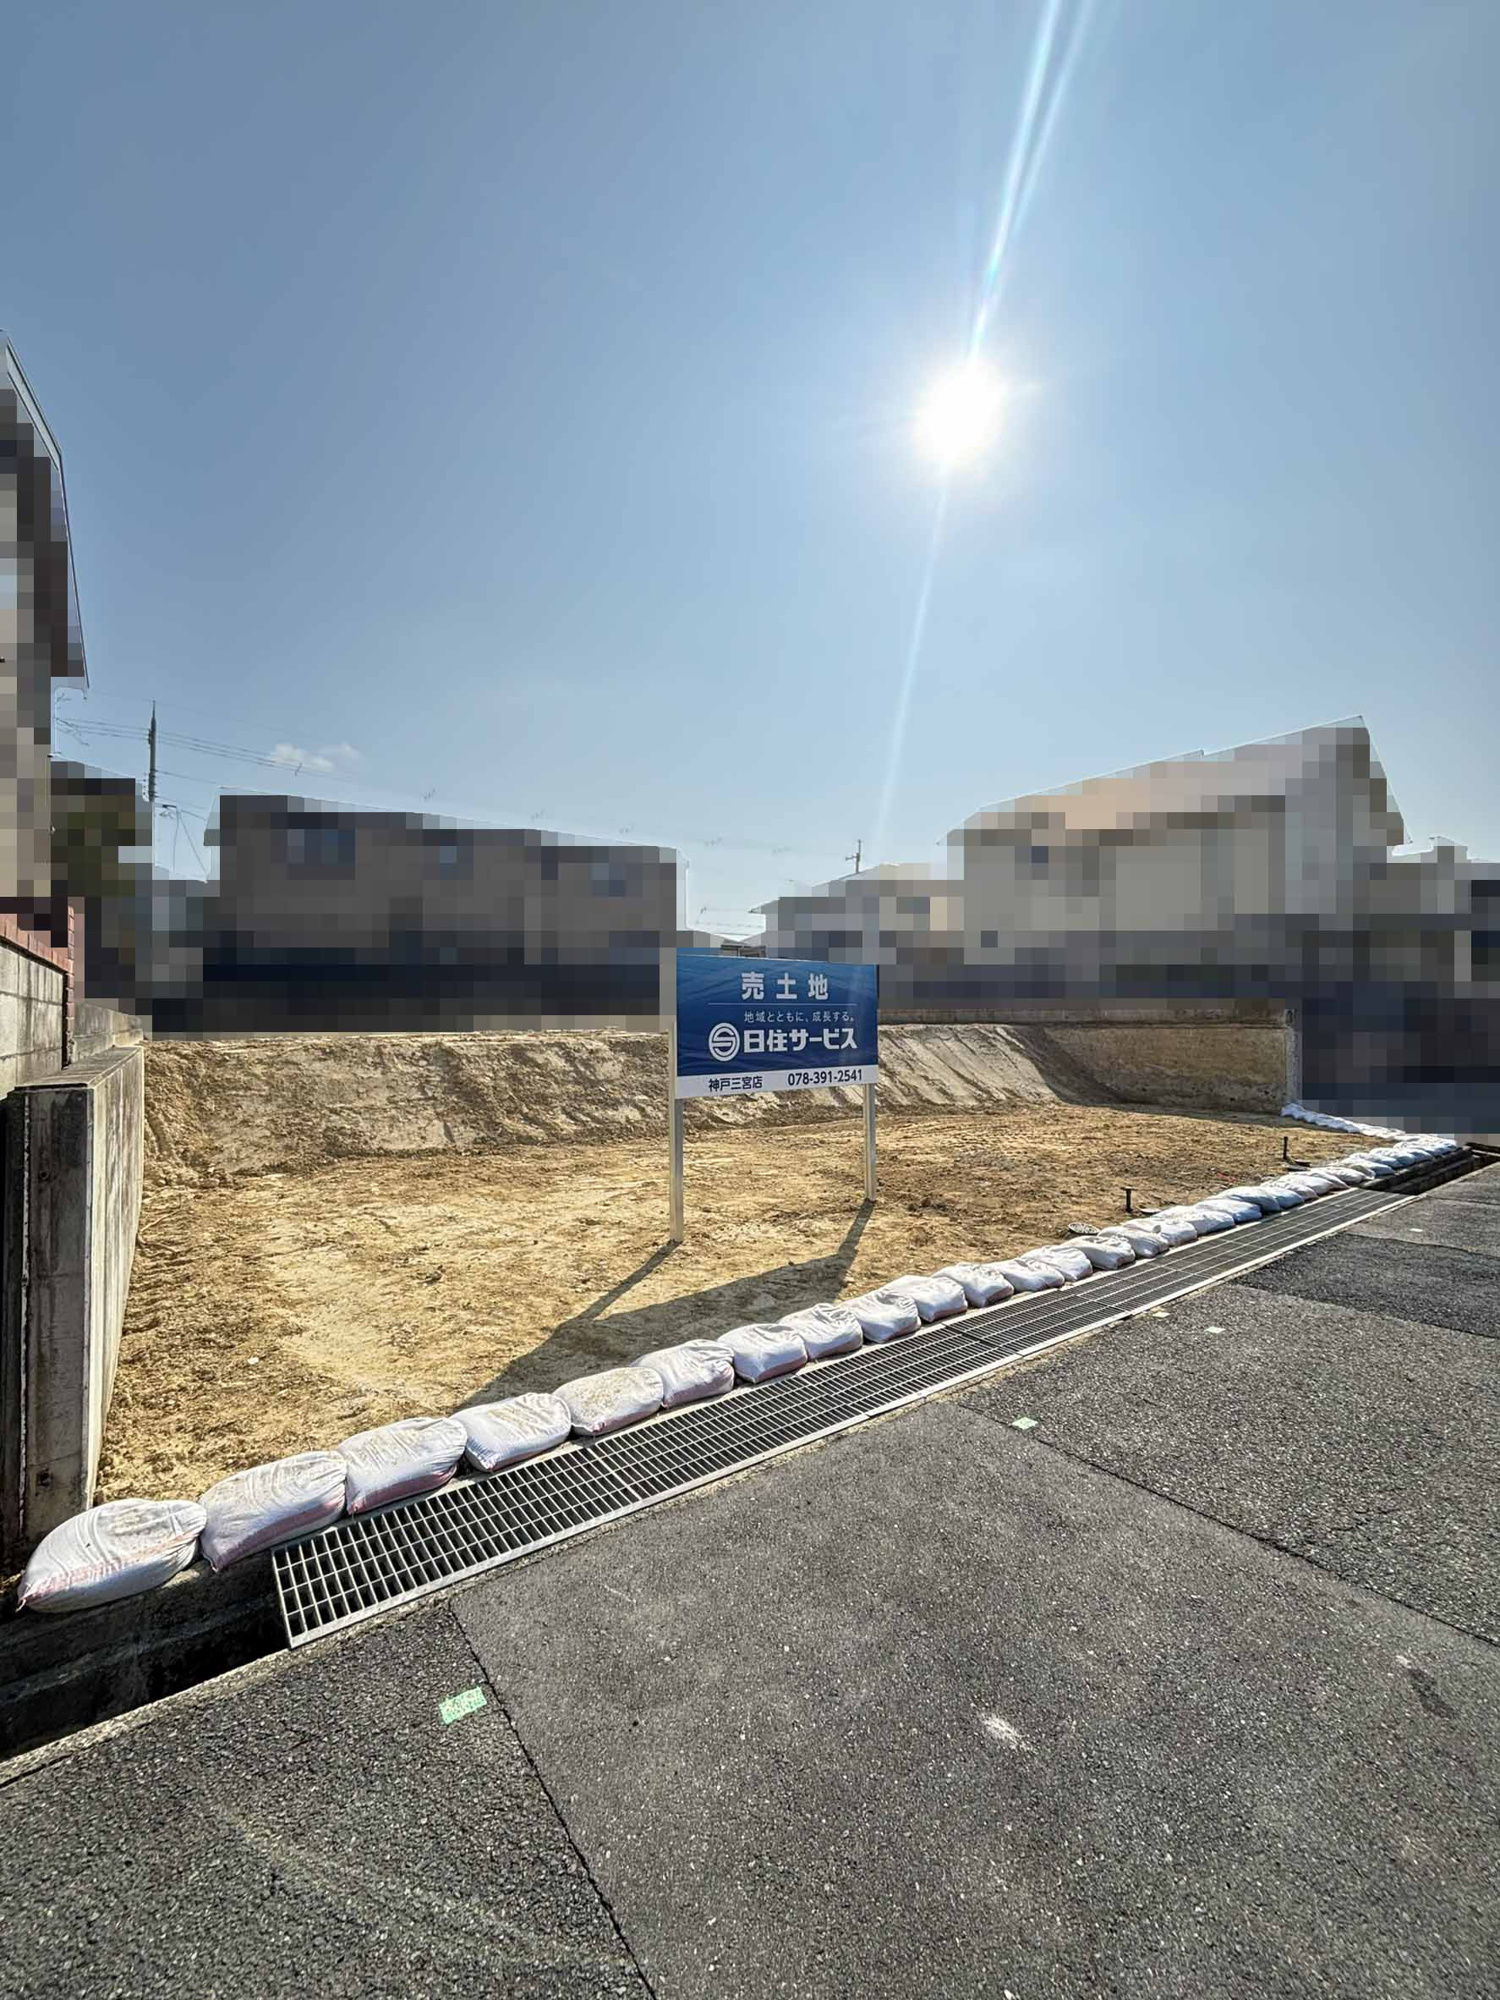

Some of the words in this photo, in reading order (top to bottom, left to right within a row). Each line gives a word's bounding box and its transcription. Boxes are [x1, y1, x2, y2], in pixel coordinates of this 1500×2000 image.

[743, 1011, 855, 1023] 地域とともに、成長する。
[743, 1028, 858, 1053] 日住サービス
[708, 1076, 763, 1092] 神戸三宮店
[787, 1069, 863, 1086] 078-391-2541
